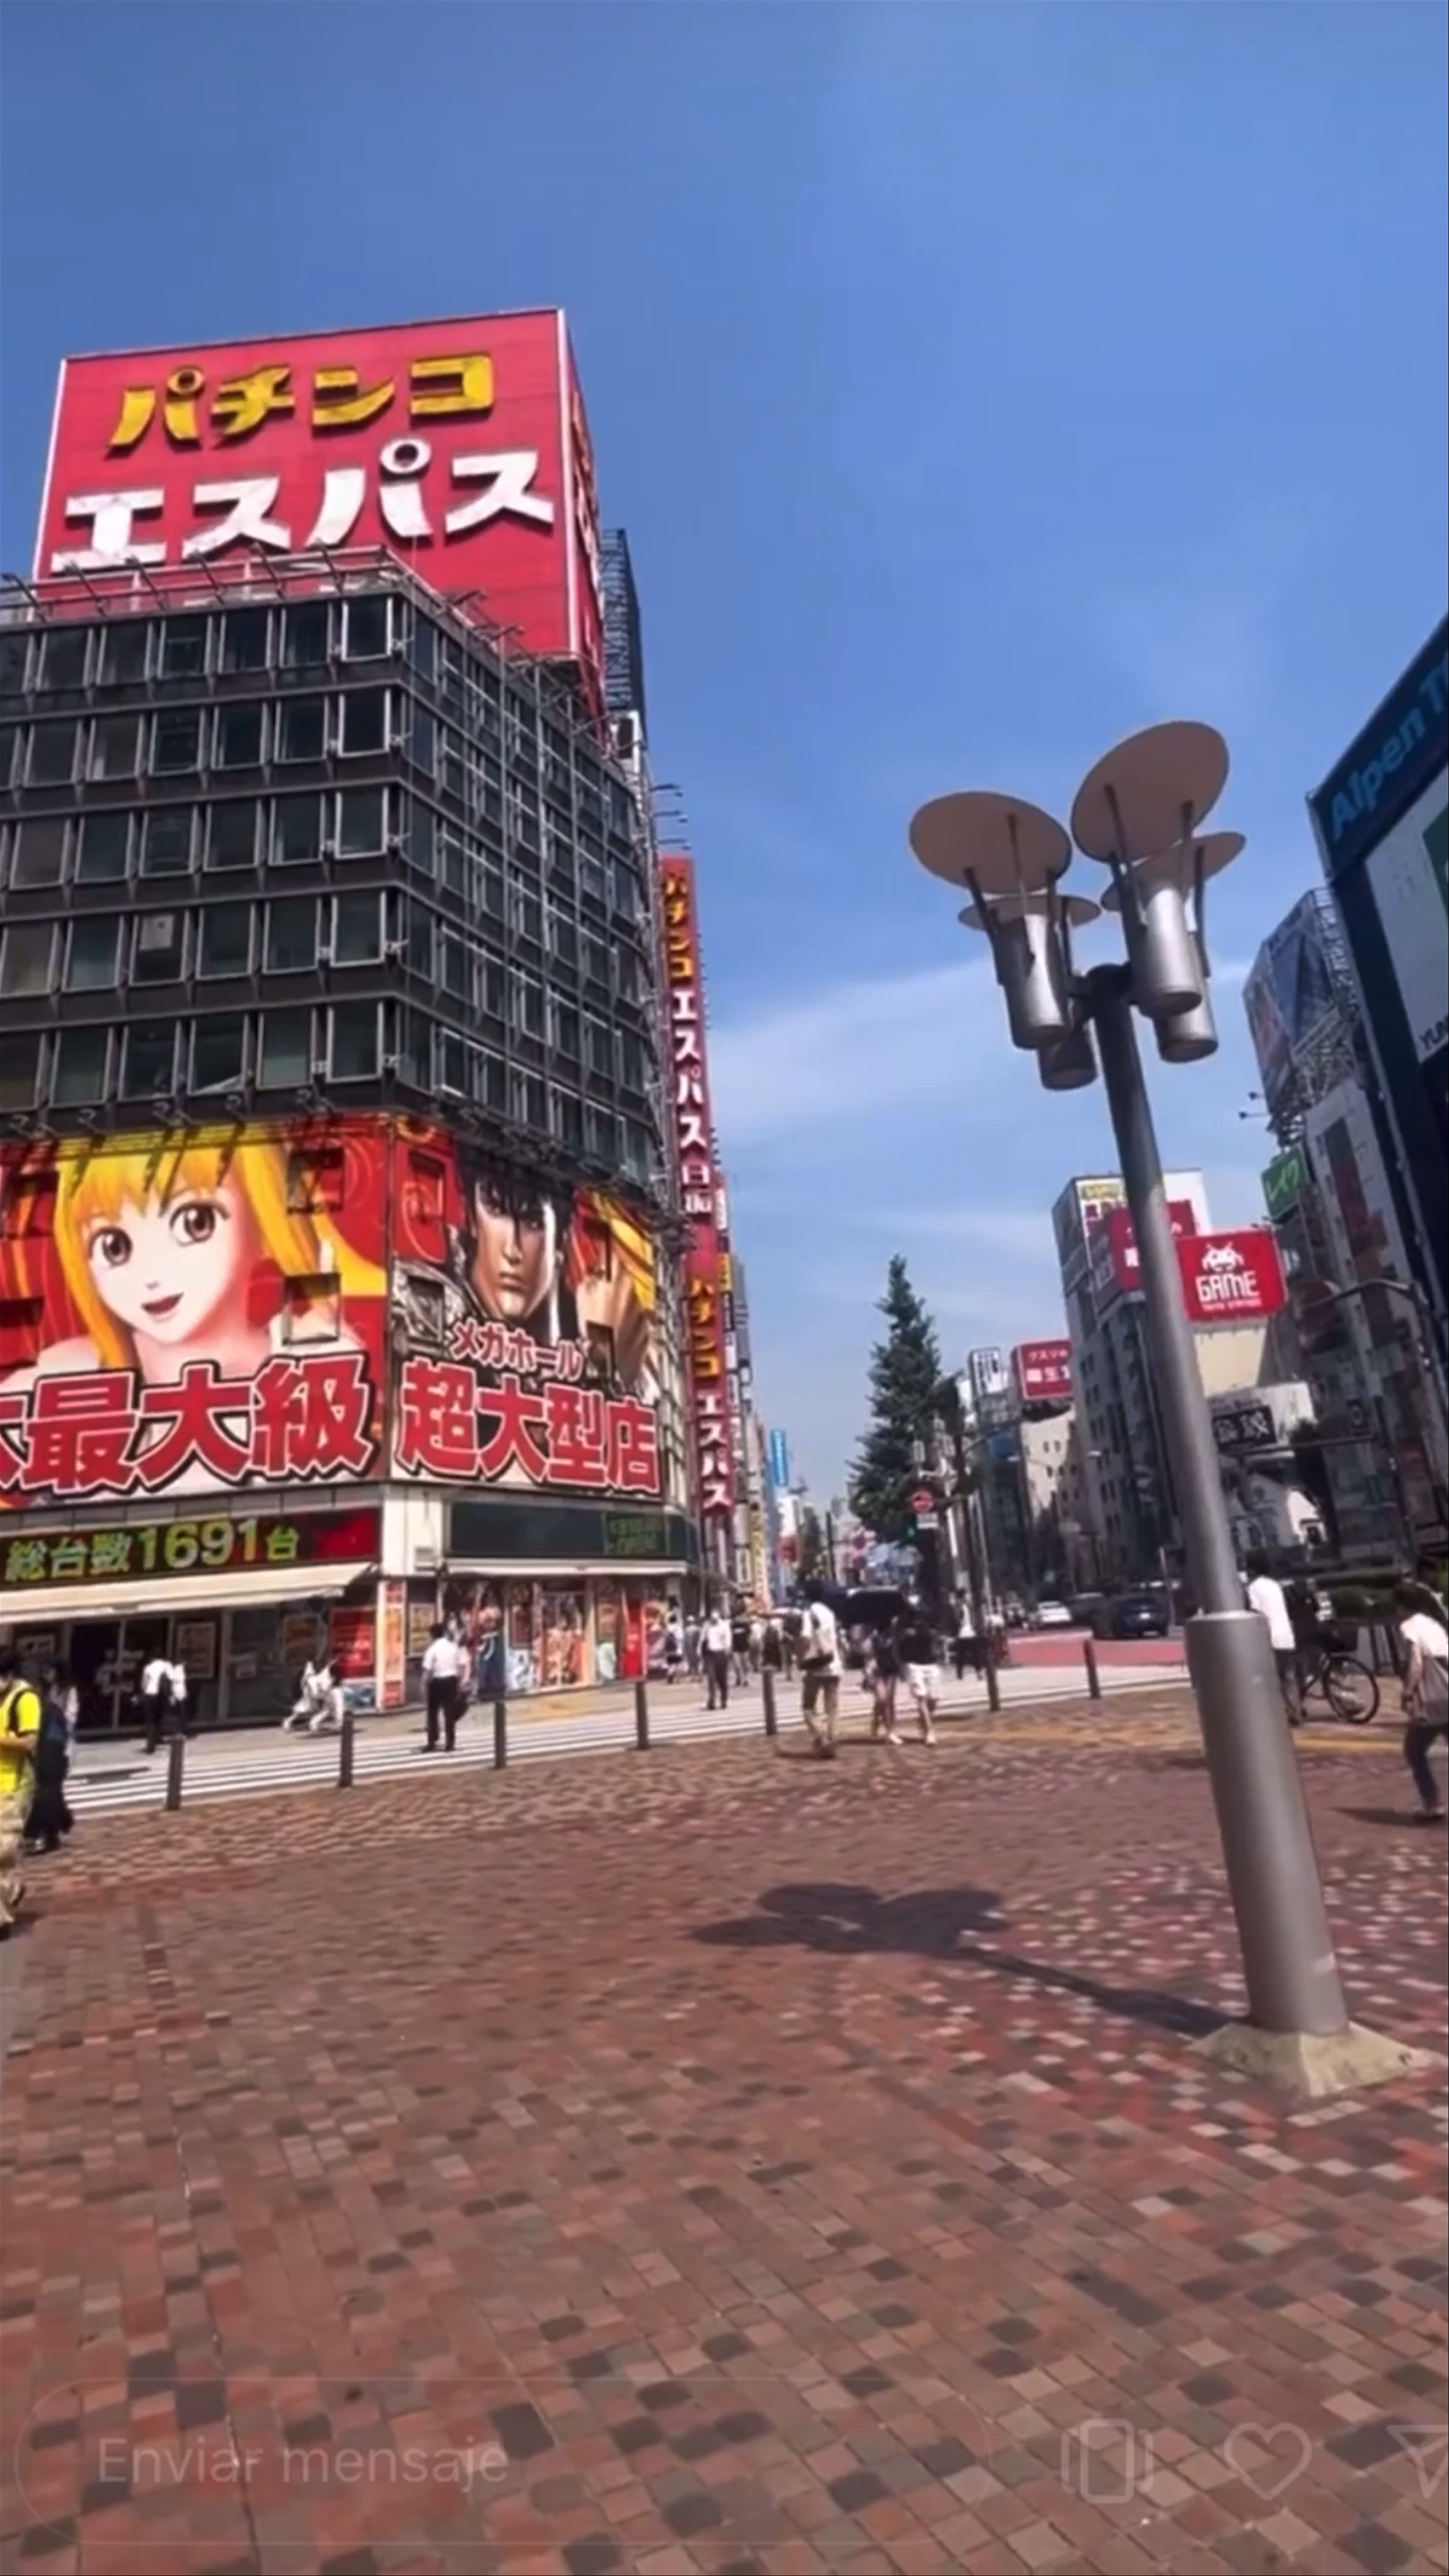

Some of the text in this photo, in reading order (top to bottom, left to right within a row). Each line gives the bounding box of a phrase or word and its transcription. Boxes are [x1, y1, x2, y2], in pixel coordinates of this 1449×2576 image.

[108, 353, 495, 449] パチンコ
[51, 438, 555, 573] エスパス
[1331, 706, 1426, 841] Alpen
[1195, 1270, 1260, 1303] GAME
[451, 1316, 586, 1381] メガホール
[397, 1356, 660, 1493] 超大型店
[5, 1512, 300, 1582] 総台数1691台
